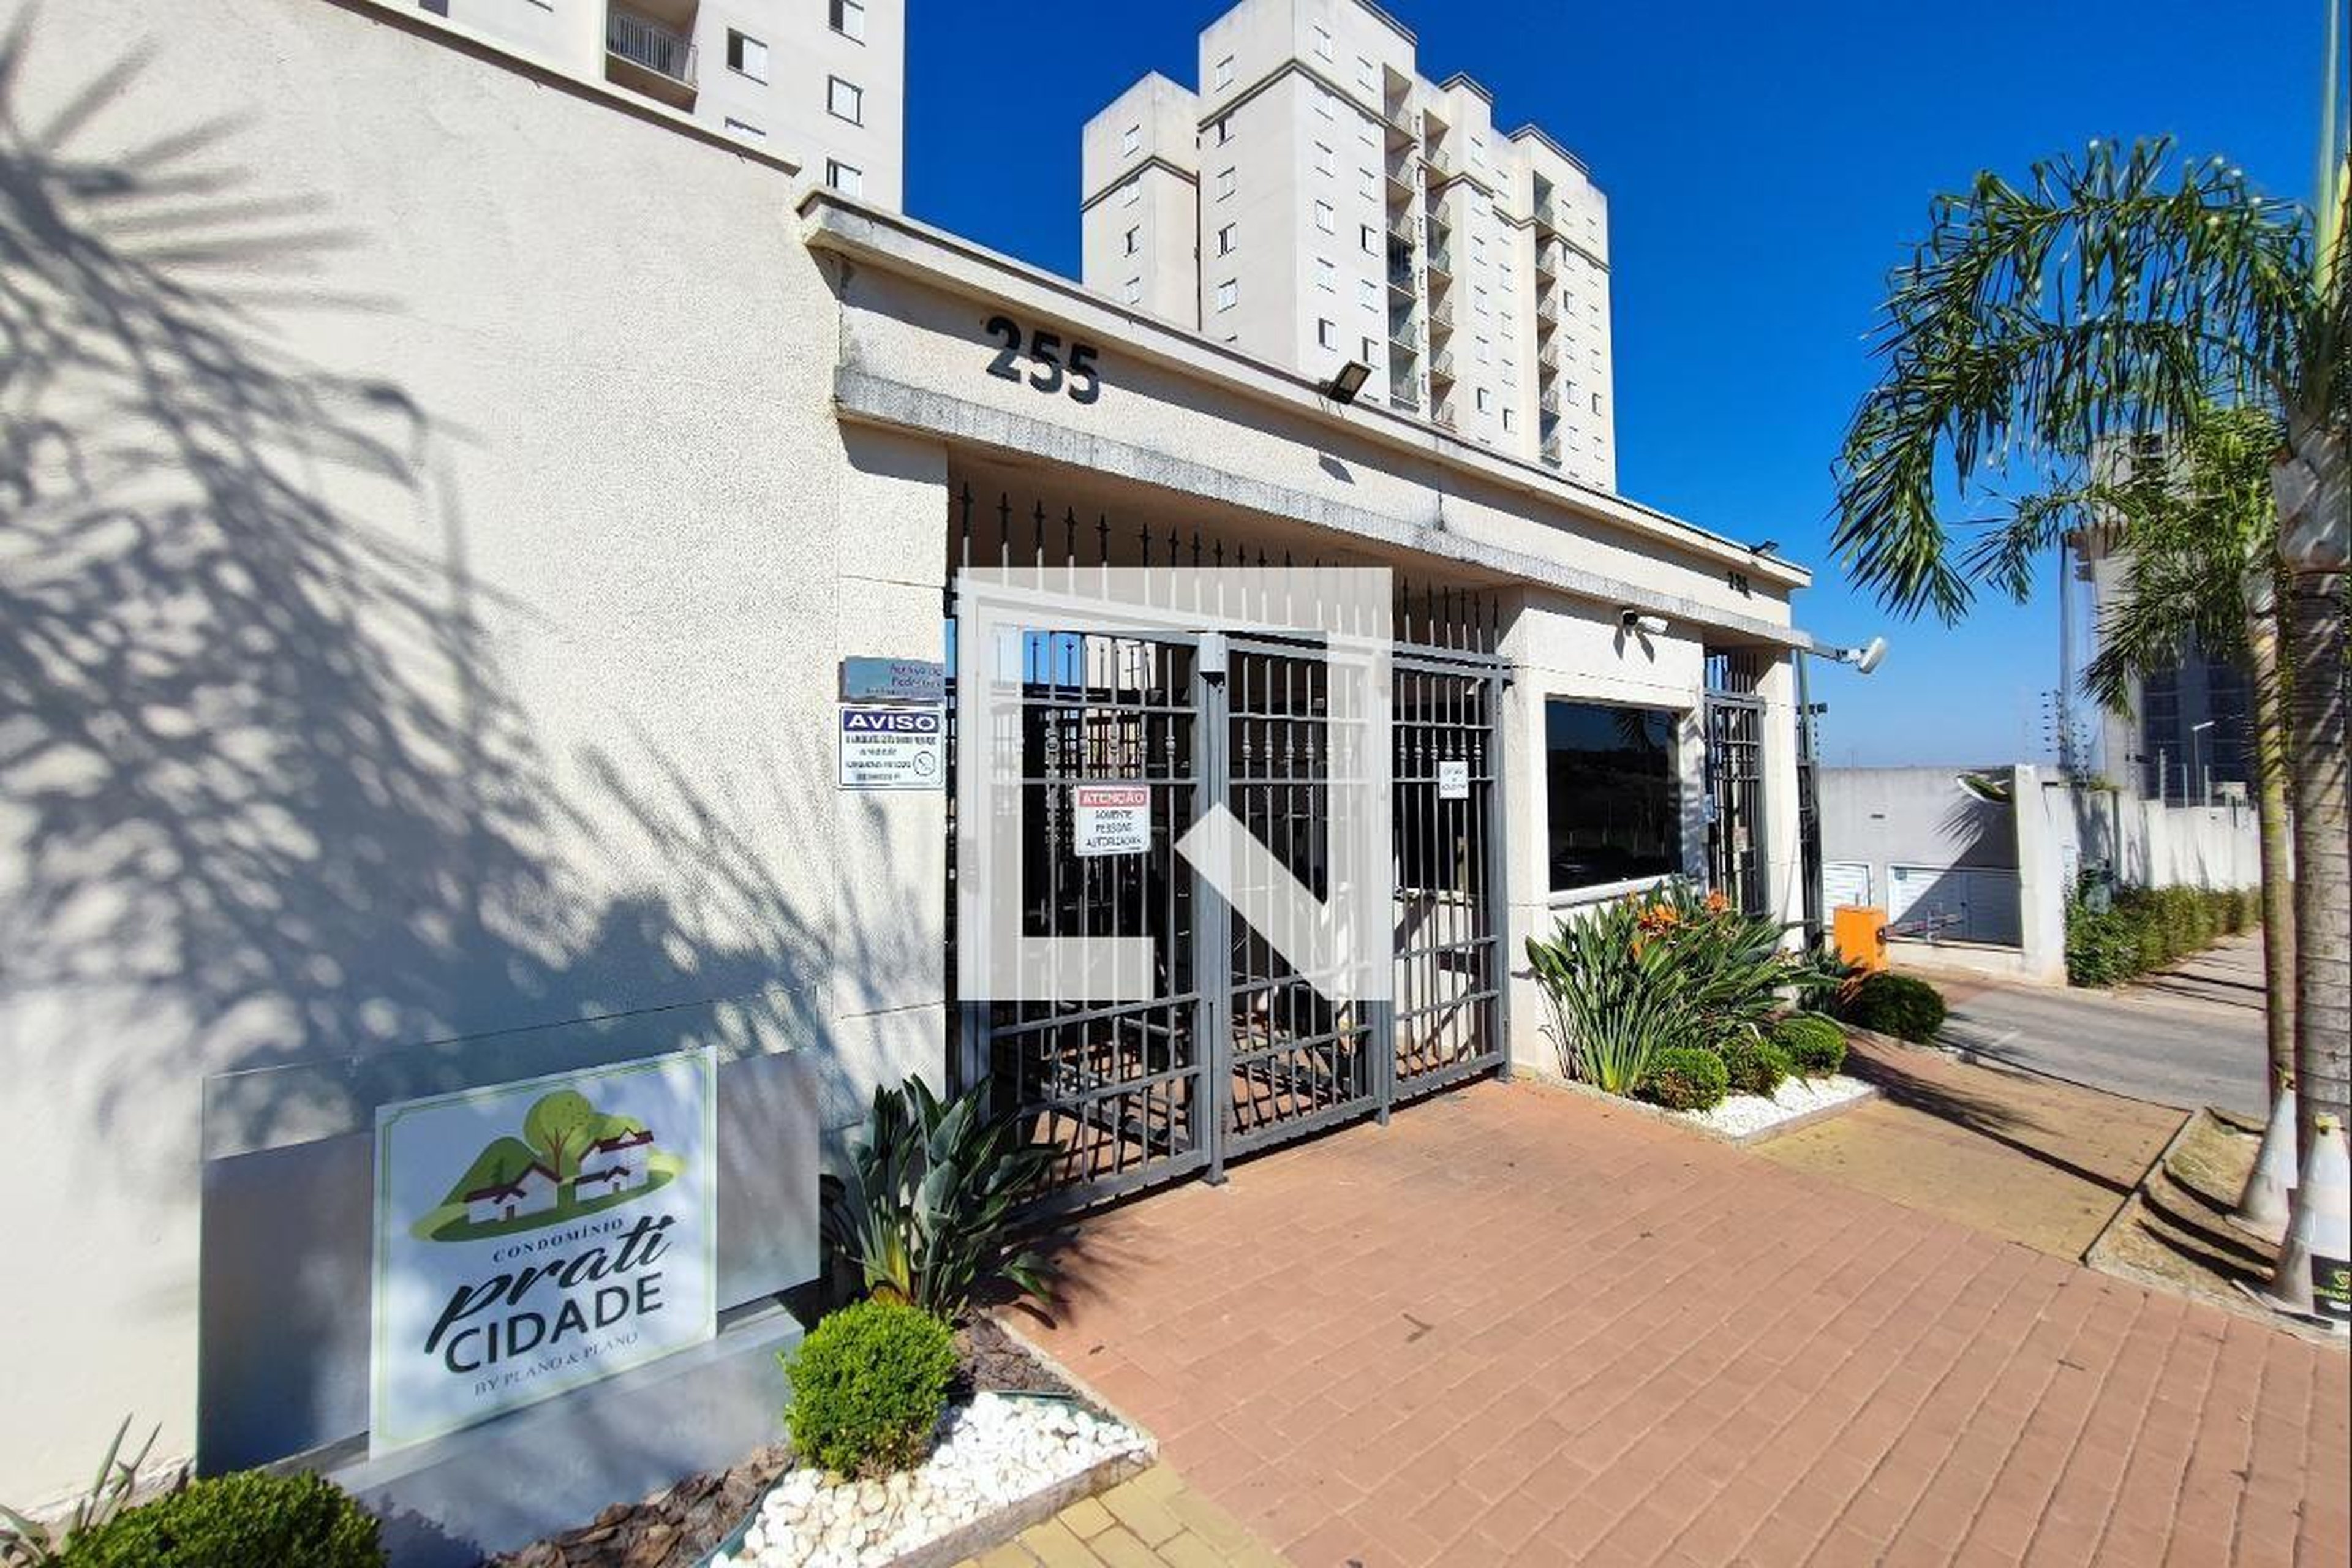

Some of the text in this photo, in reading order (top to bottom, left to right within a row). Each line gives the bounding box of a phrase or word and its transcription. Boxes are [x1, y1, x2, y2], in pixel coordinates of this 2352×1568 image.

[986, 316, 1099, 405] 255
[848, 714, 936, 731] AVISO
[1082, 791, 1144, 804] ATENÇÃO
[492, 1218, 624, 1262] CONDOMÍNIO
[424, 1215, 676, 1354] prati
[444, 1272, 663, 1373] CIDADE
[473, 1332, 638, 1396] BY PLANO & PLANO
